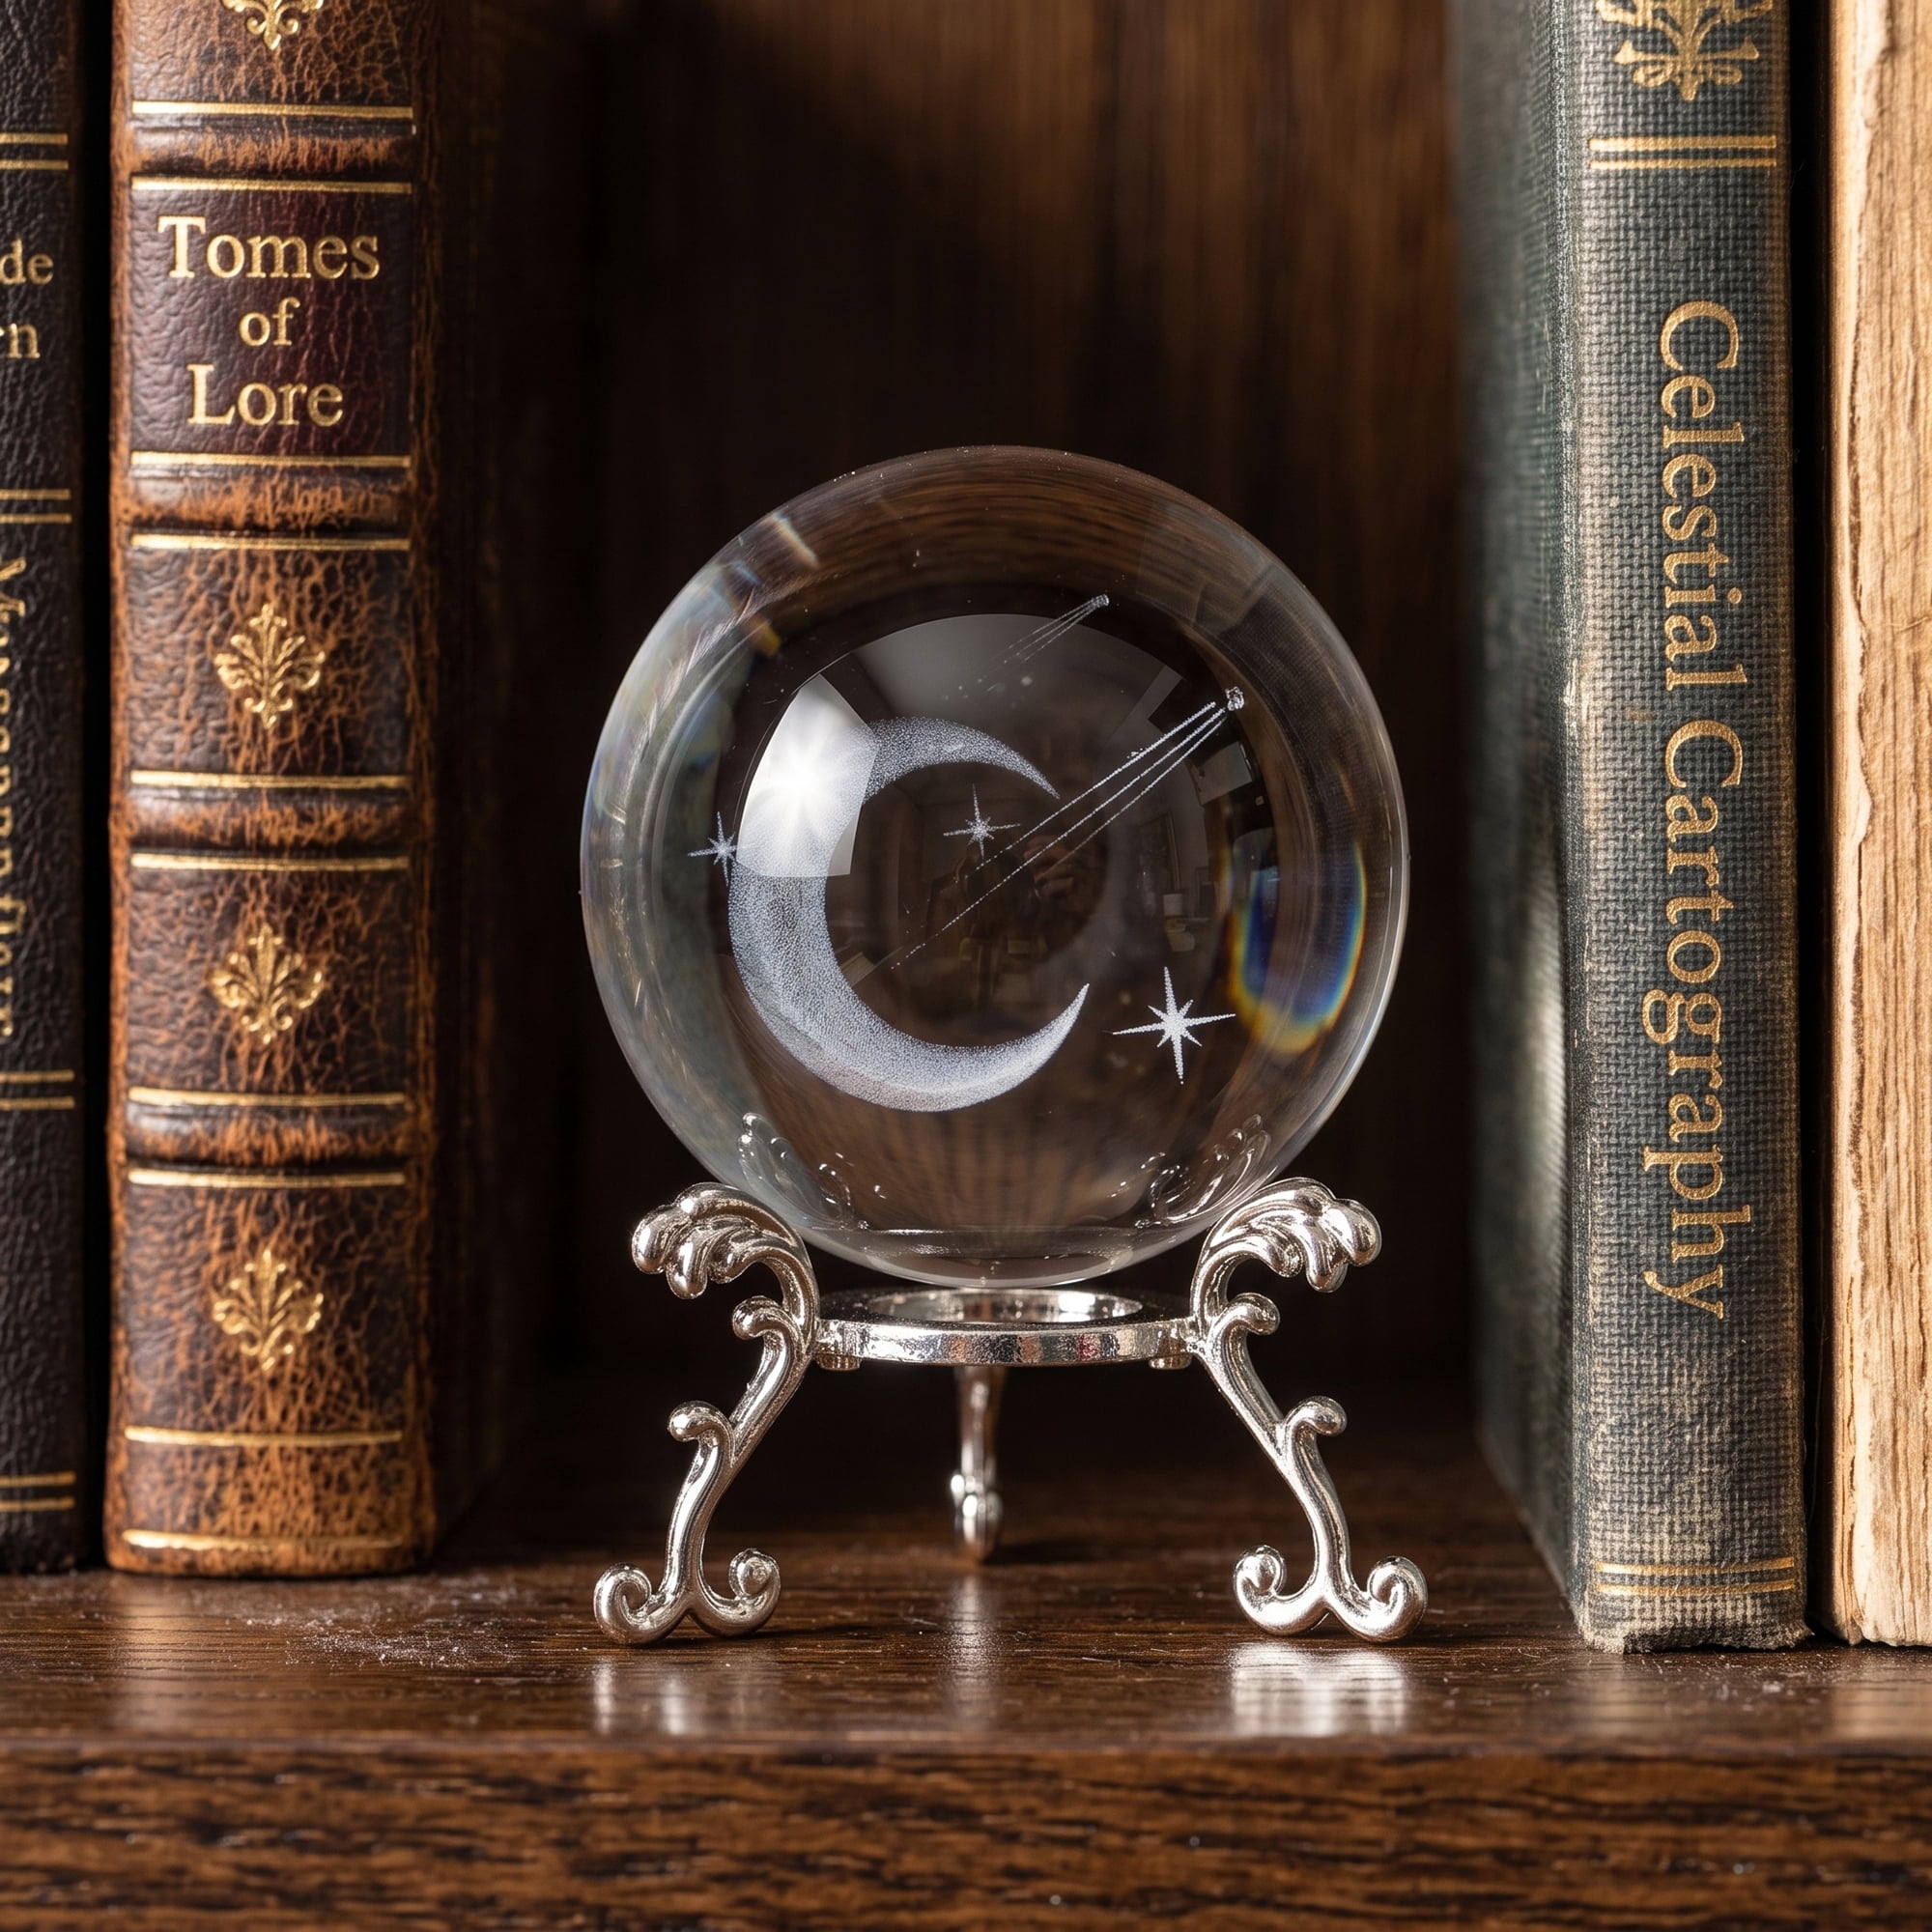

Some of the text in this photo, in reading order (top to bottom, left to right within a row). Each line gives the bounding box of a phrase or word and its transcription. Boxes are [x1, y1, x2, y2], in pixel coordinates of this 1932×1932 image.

[157, 215, 381, 280] Tomes
[239, 298, 300, 347] of
[186, 364, 344, 427] Lore
[1642, 300, 1751, 1319] Celestial Cartography
